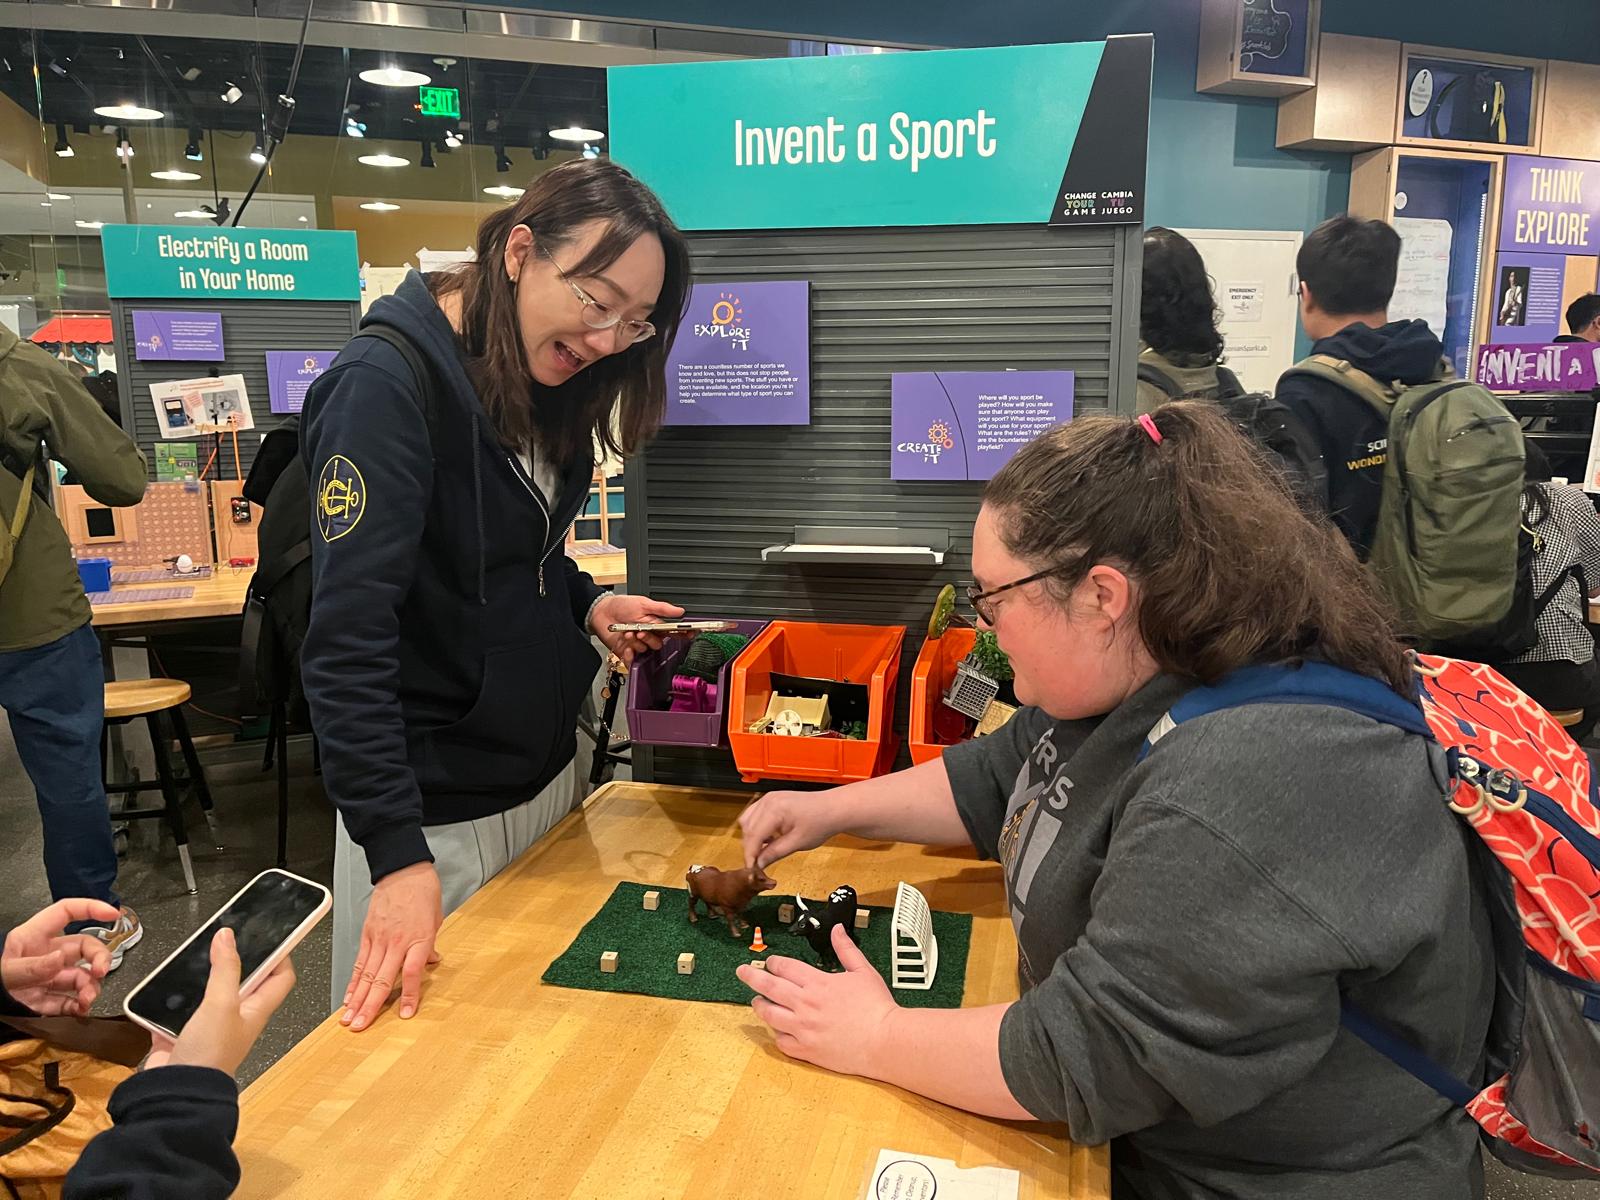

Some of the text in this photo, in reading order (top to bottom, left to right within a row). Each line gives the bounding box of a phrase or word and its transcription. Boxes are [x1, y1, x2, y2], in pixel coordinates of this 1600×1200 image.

[428, 90, 453, 112] EXIT
[735, 109, 997, 172] Invent a Sport
[1530, 167, 1584, 204] THINK
[1067, 200, 1095, 208] YOUR
[1110, 199, 1125, 207] TU
[1515, 209, 1590, 246] EXPLORE
[158, 234, 308, 264] Electrify a Room
[179, 266, 295, 290] in Your Home
[694, 324, 750, 339] EXPLORE
[897, 442, 942, 454] CREATE
